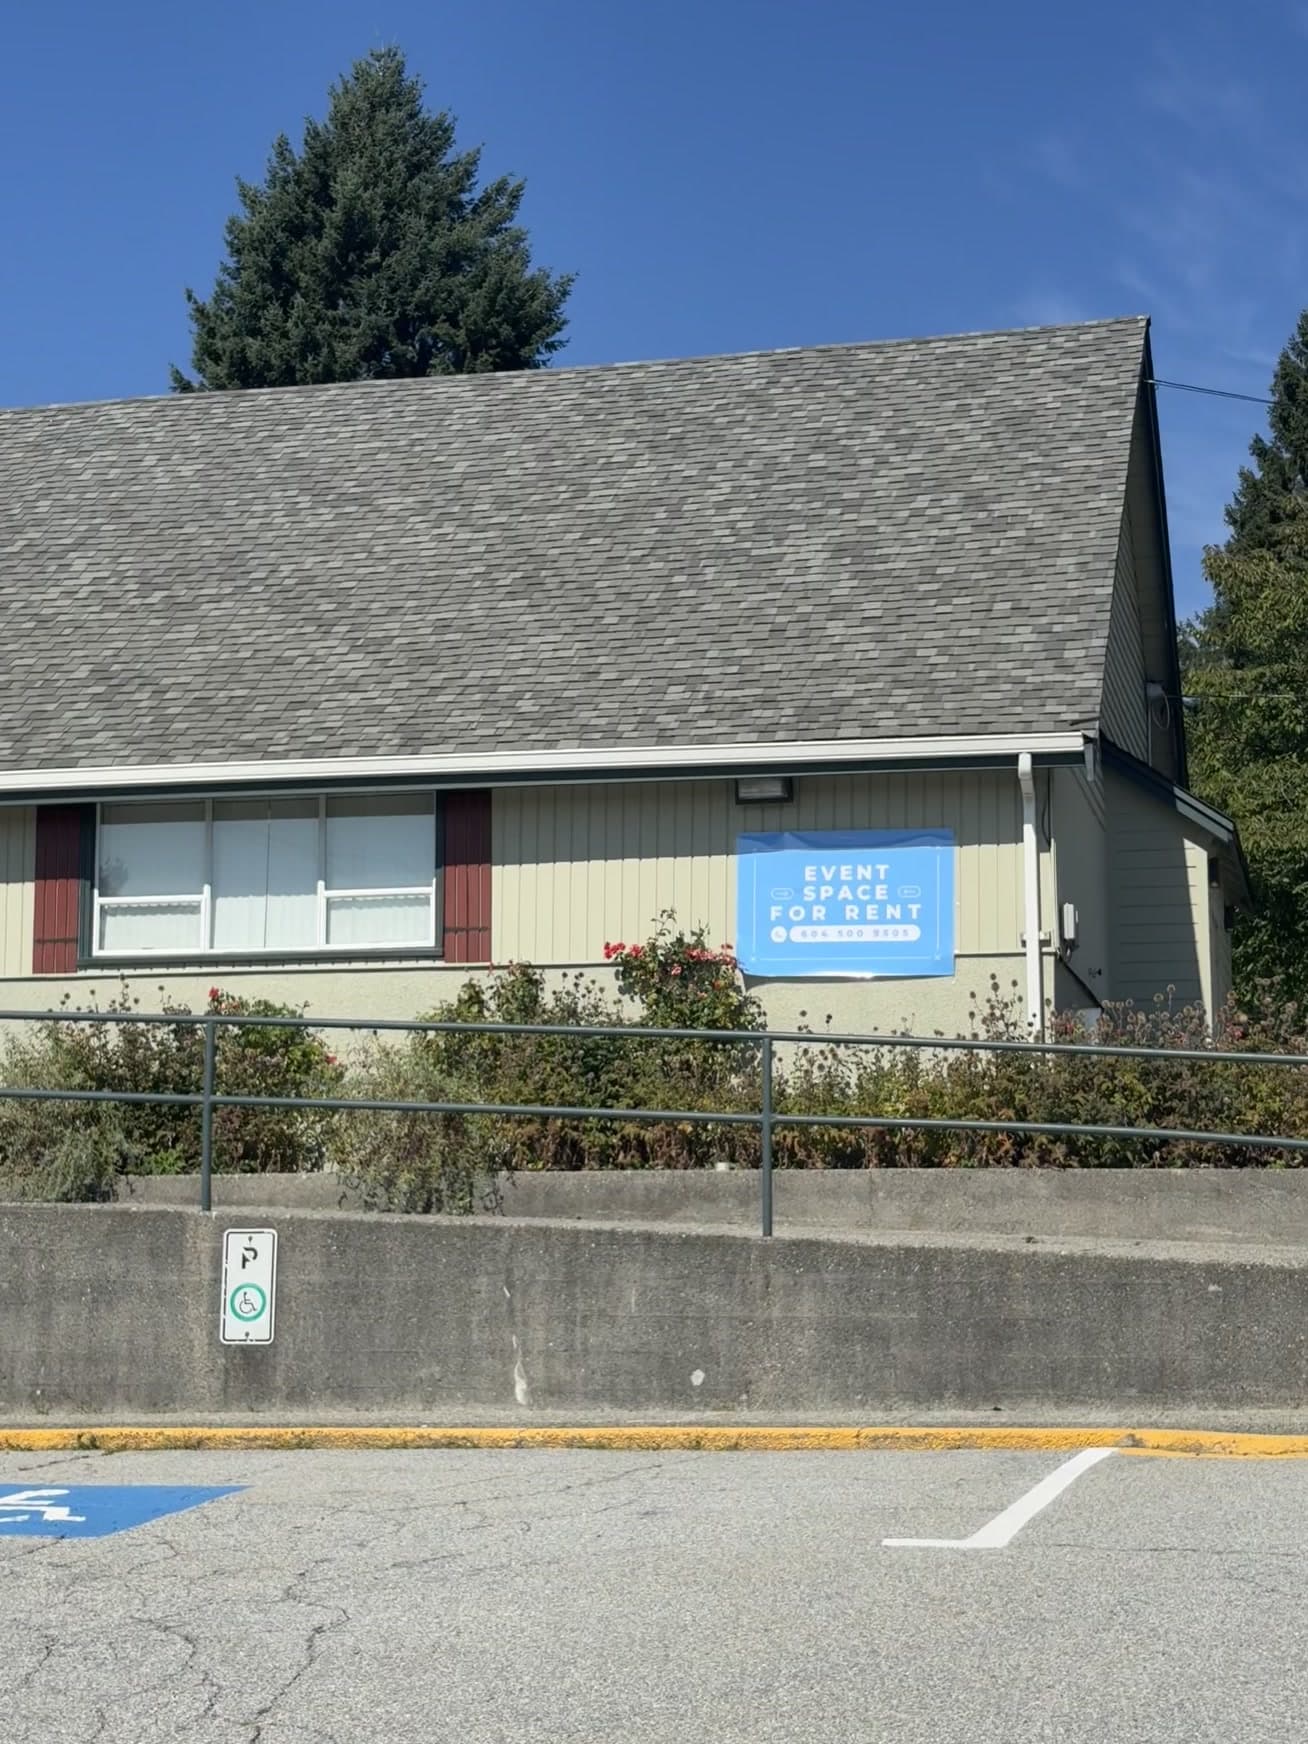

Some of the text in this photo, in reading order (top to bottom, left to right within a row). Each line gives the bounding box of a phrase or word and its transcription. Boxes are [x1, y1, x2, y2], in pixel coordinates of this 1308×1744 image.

[804, 864, 889, 881] EVENT
[803, 884, 889, 901] SPACE
[770, 903, 921, 921] FOR RENT
[242, 1247, 258, 1269] P
